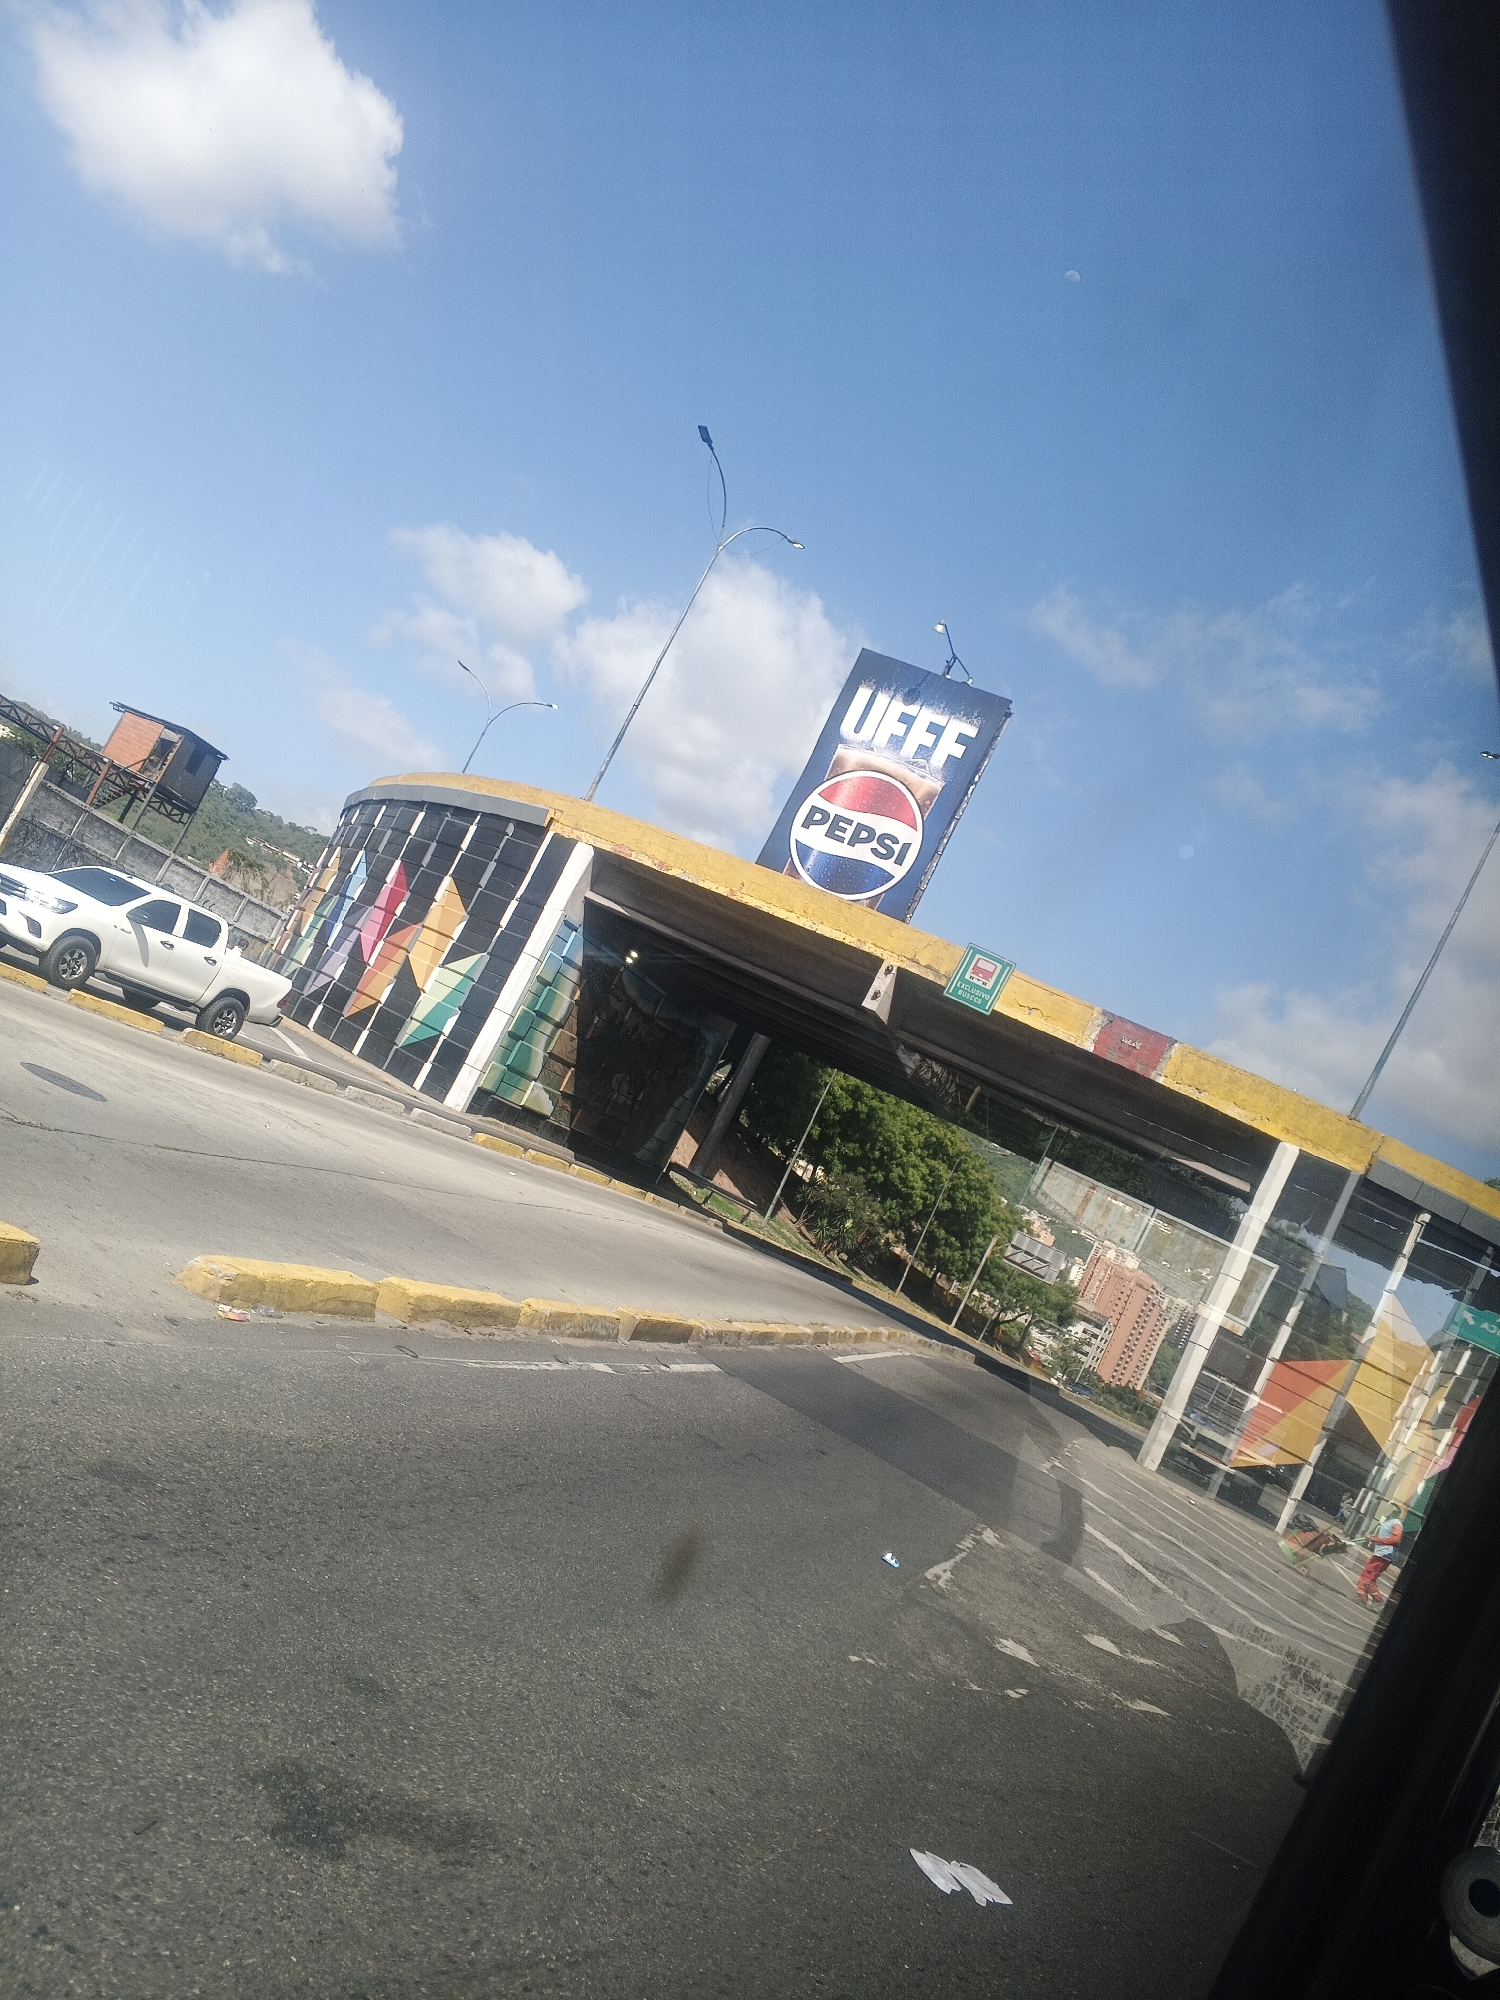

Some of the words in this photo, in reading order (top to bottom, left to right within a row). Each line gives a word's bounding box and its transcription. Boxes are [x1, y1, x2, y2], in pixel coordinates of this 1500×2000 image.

[839, 685, 980, 769] UFFF
[801, 805, 912, 866] PEPSI
[957, 981, 990, 1000] EXCLUSIVO
